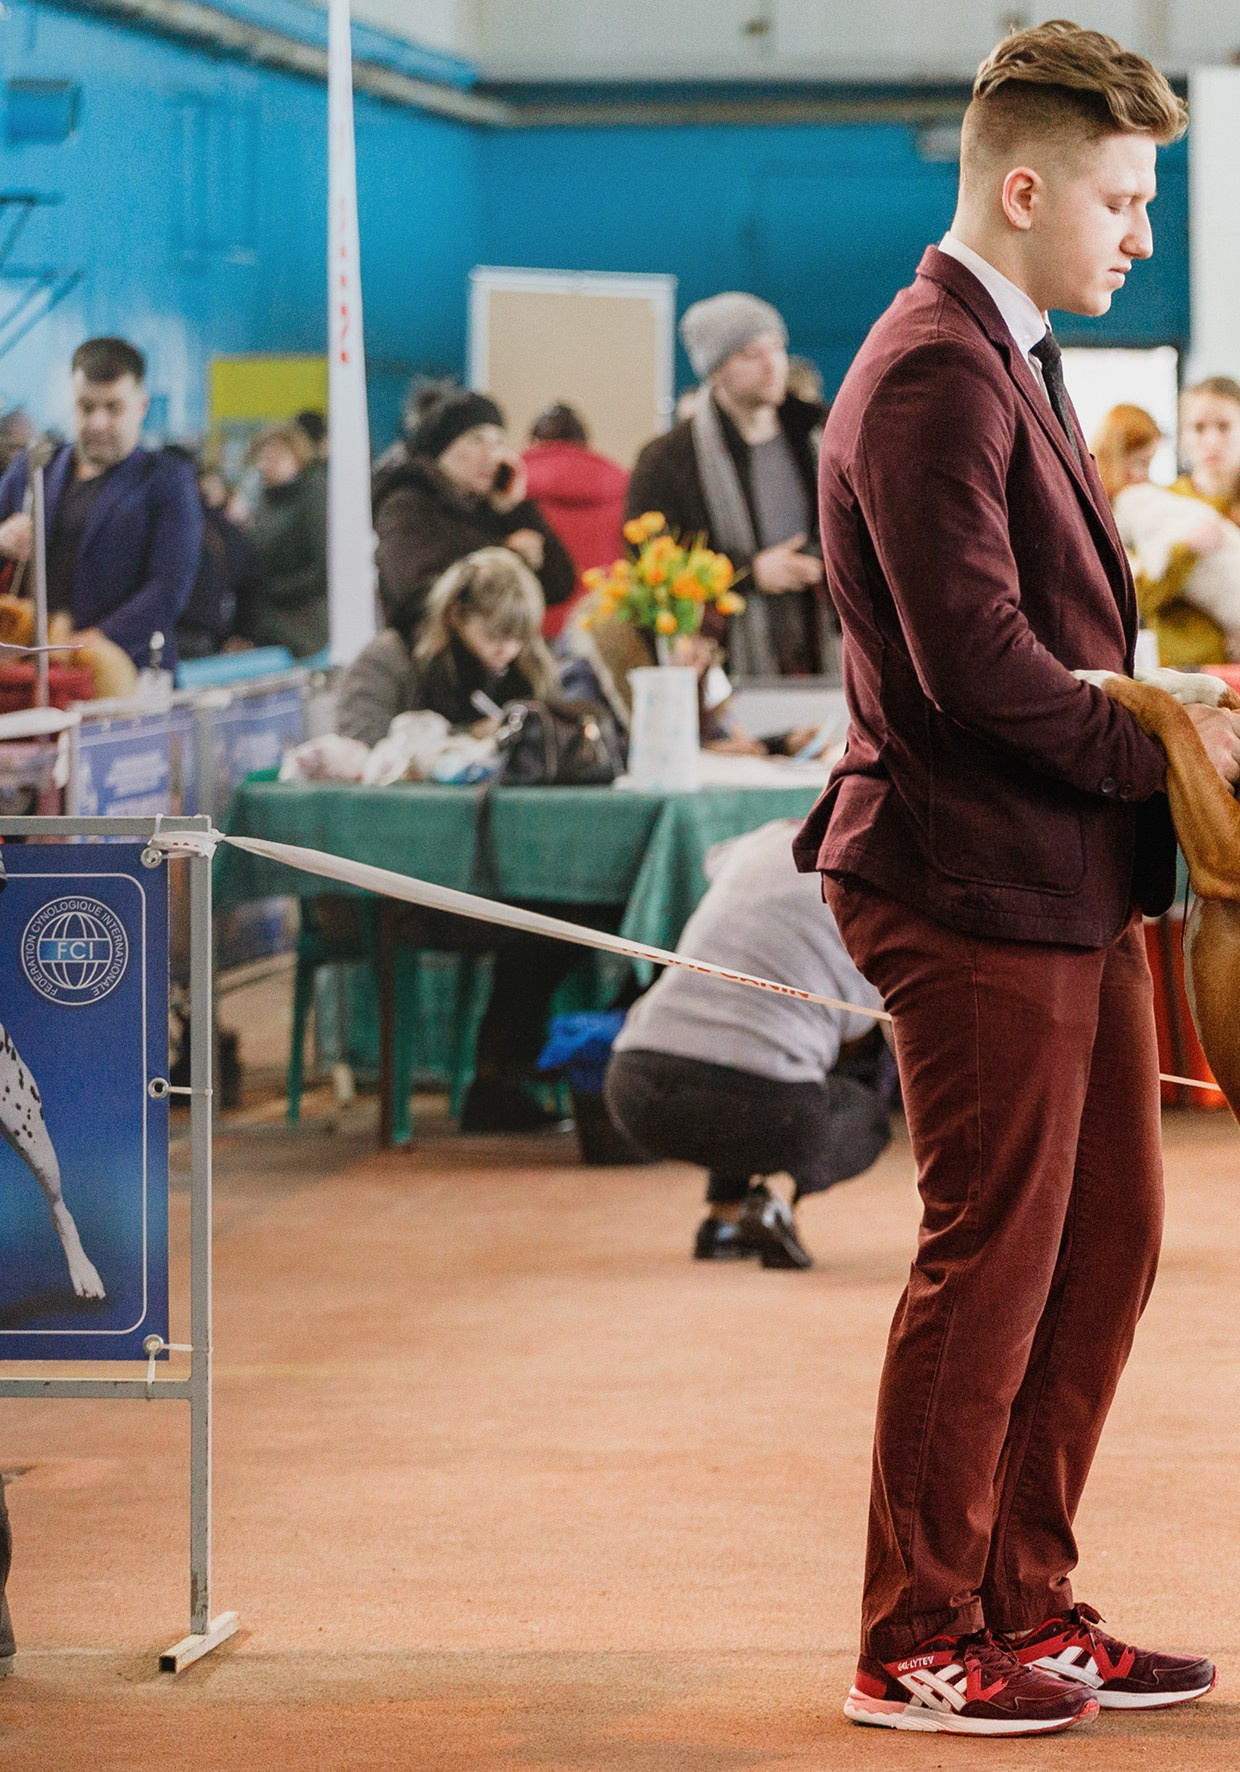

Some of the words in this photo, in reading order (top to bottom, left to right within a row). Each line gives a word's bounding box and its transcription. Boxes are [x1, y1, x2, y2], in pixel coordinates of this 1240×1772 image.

[31, 901, 103, 933] CYNOLOGIQUE
[90, 912, 124, 996] INTERNATIONALE
[57, 941, 94, 960] FCI
